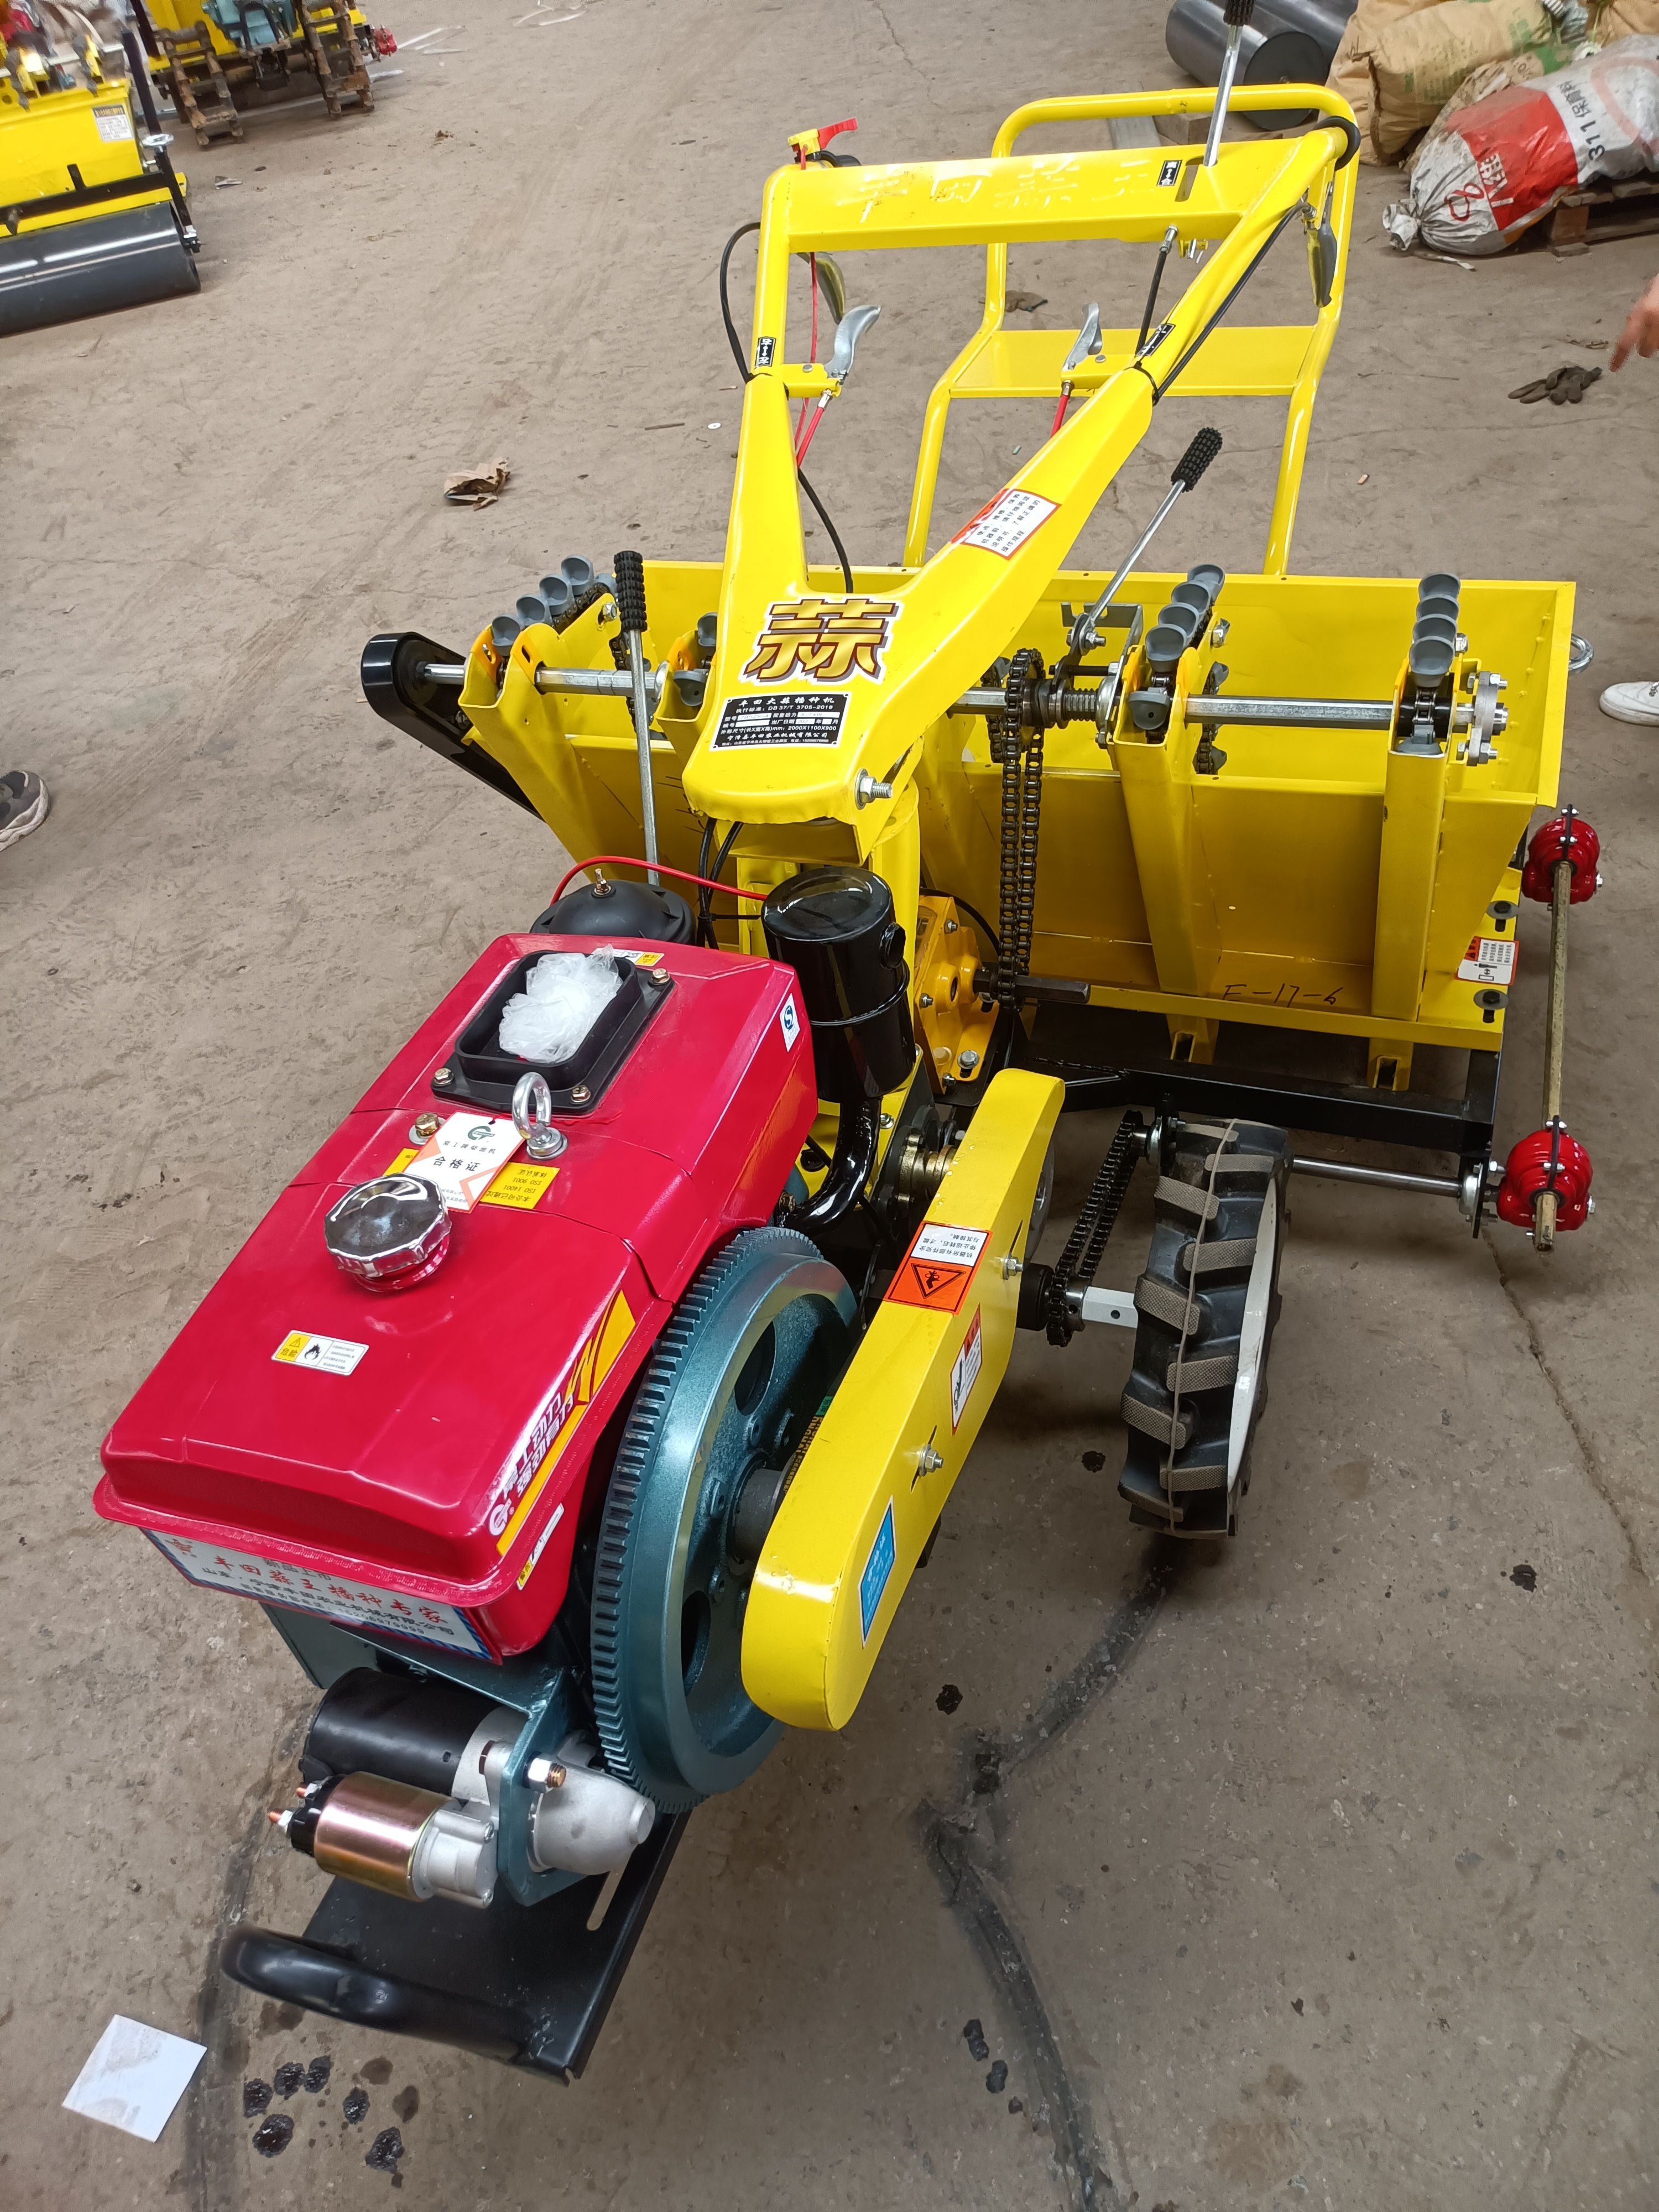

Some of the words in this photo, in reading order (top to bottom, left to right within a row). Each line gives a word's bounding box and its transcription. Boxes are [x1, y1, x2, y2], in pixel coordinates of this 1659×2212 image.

[744, 599, 898, 681] 蒜
[433, 1156, 481, 1172] 合格证
